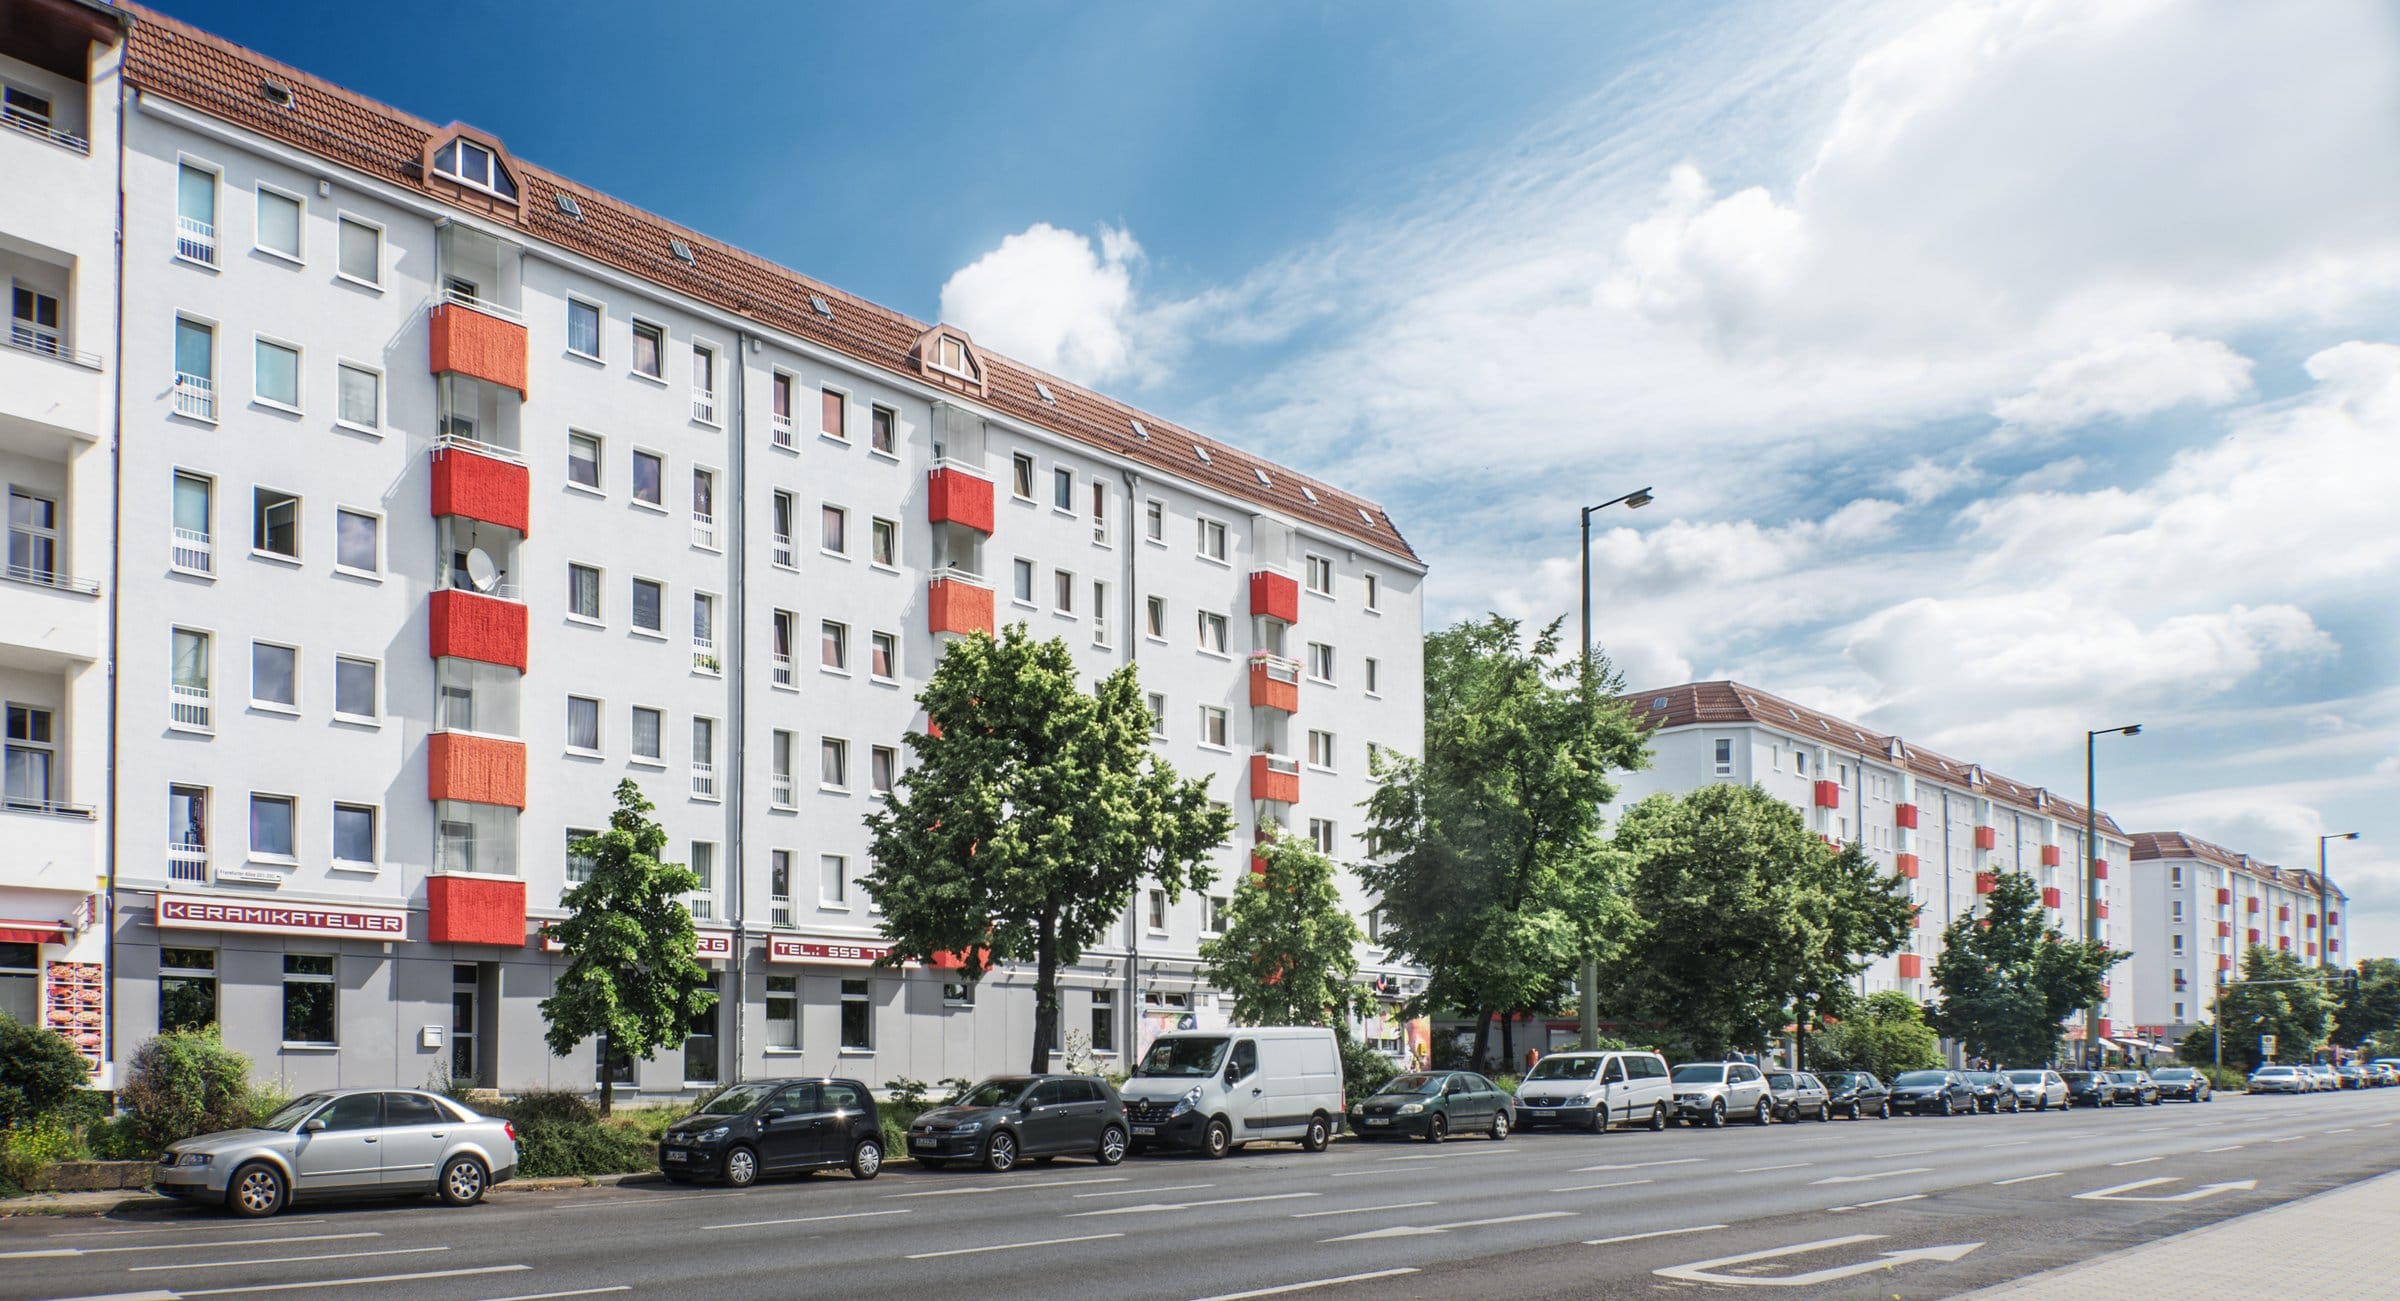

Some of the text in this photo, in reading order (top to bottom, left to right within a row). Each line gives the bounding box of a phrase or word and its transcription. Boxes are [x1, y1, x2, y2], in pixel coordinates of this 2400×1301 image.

[167, 903, 400, 930] KERAMIKATELIER
[778, 943, 820, 956] TEL.:
[828, 946, 861, 958] 559
